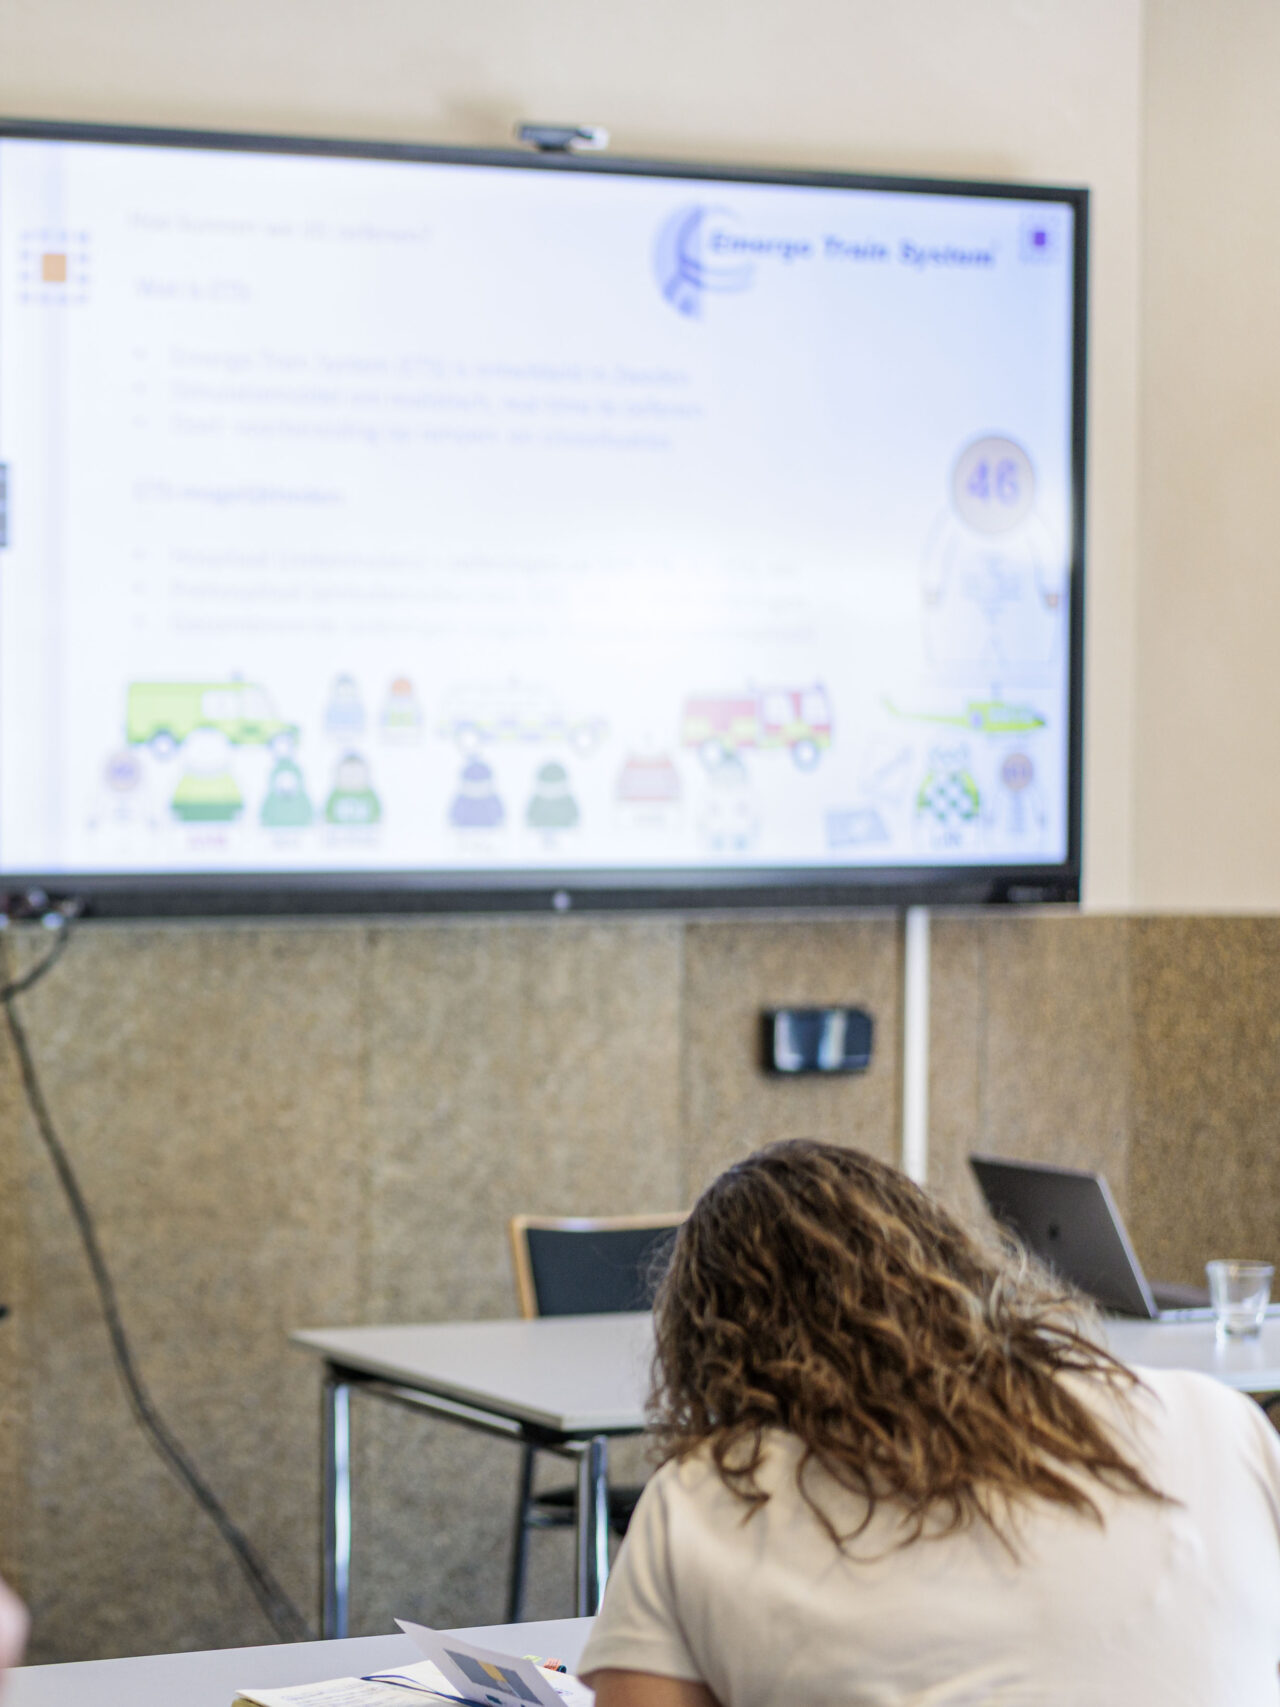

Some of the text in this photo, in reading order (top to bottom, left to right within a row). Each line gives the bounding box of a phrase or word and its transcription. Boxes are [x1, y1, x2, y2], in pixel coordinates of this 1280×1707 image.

[824, 234, 888, 261] Train
[900, 240, 993, 271] System
[966, 455, 1019, 507] 46
